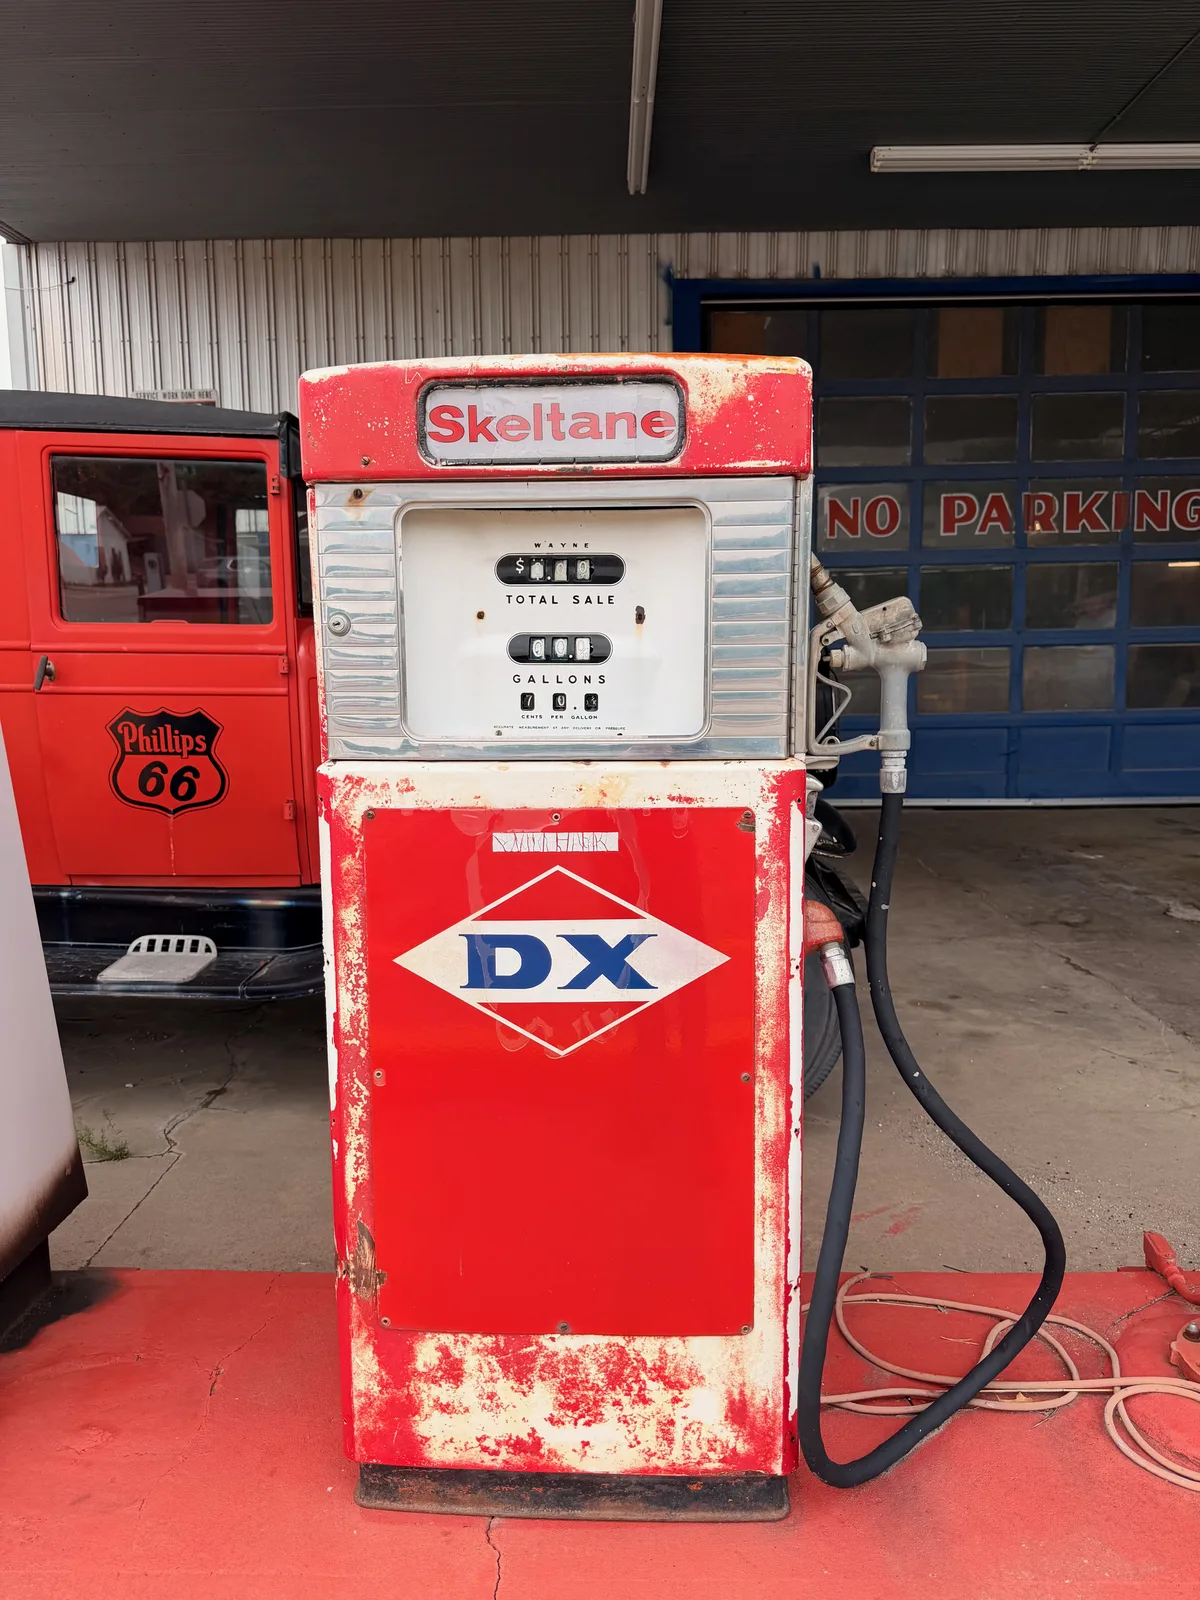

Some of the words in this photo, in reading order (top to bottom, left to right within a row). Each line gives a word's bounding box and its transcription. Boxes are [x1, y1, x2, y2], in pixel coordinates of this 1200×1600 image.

[136, 392, 158, 400] SERVICE
[162, 392, 178, 400] WORK
[181, 391, 196, 399] DONE
[198, 390, 212, 398] HERE
[428, 403, 677, 443] Skeltane
[826, 496, 901, 539] NO
[940, 489, 1200, 536] PARKING
[506, 595, 558, 604] TOTAL
[572, 596, 614, 604] SALE
[512, 674, 606, 684] GALLONS
[117, 721, 207, 759] Phillips
[138, 760, 200, 802] 66
[458, 933, 659, 990] DX
